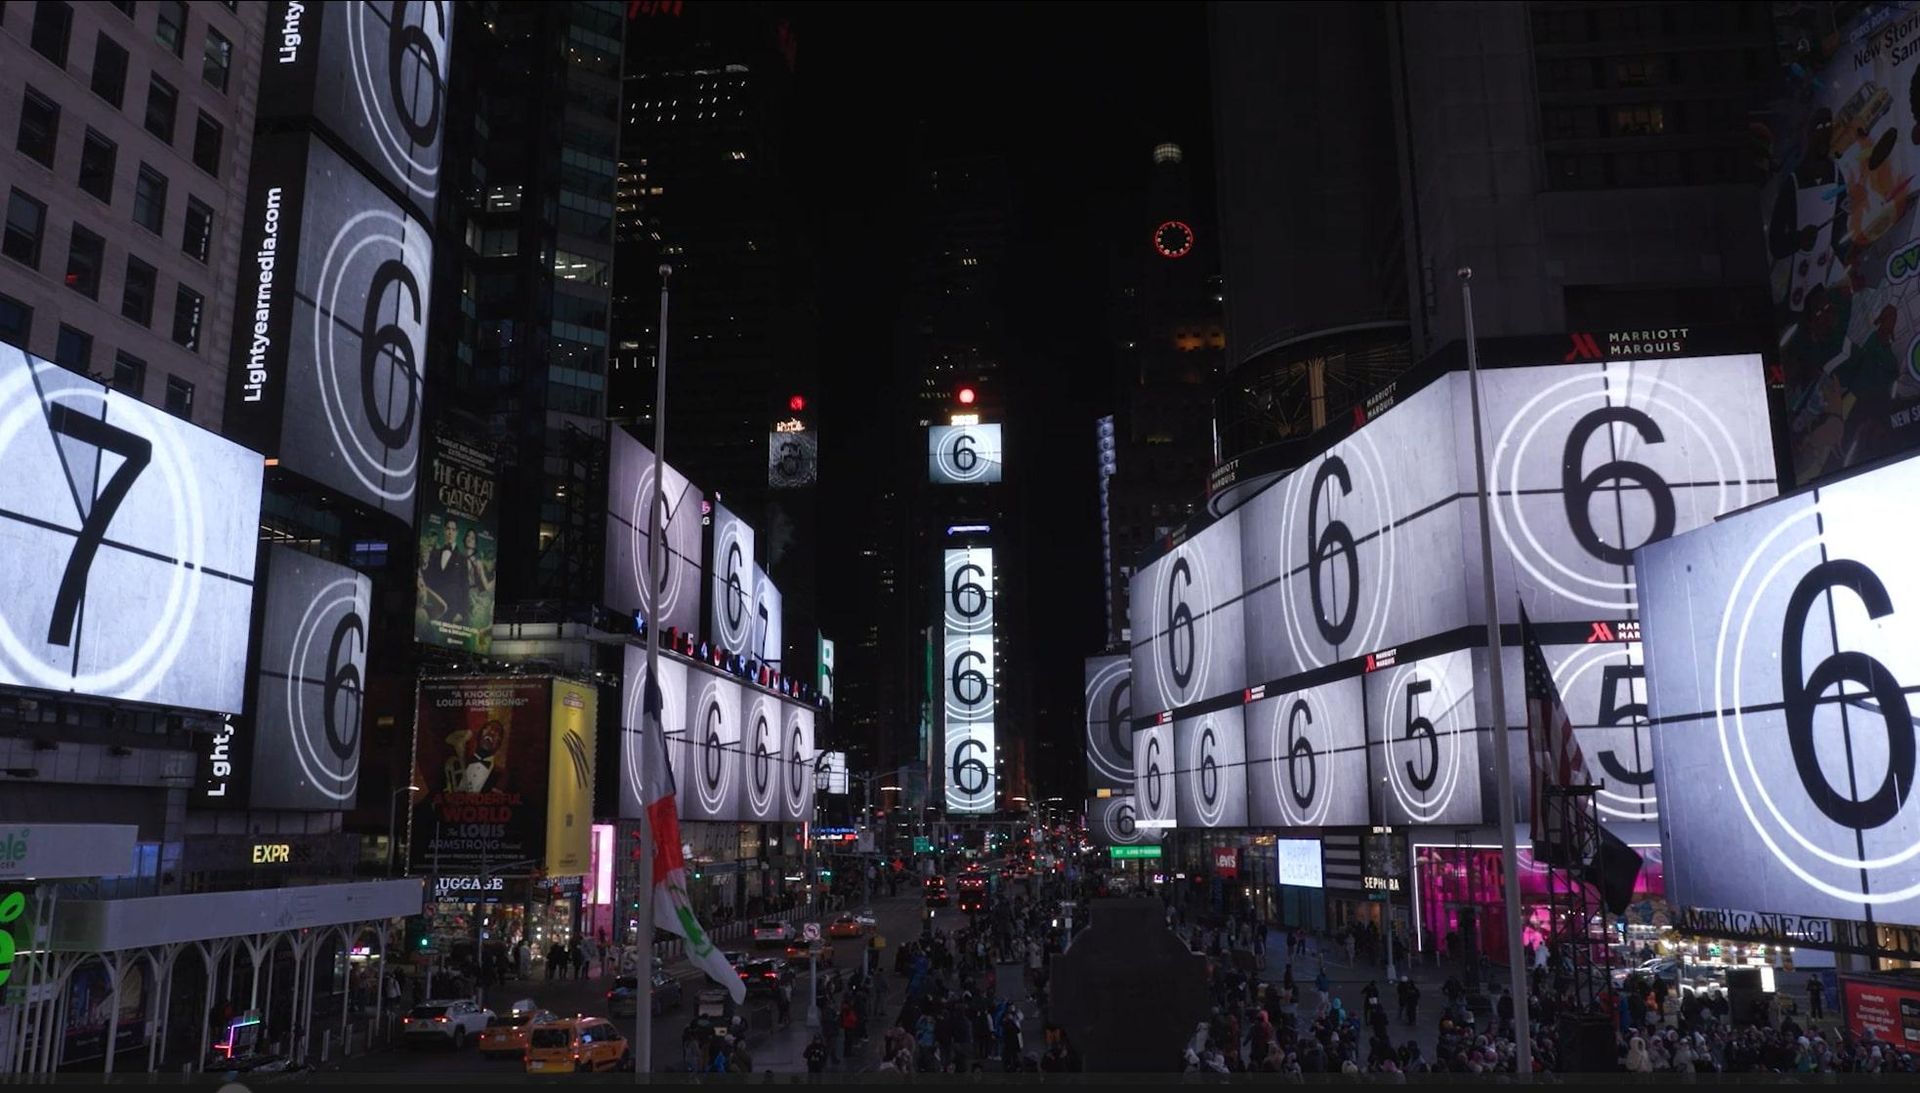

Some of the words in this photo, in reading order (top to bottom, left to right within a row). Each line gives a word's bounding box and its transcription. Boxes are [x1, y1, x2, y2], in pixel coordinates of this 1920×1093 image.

[244, 187, 281, 402] Lightyearmedia.com
[361, 259, 421, 450] 6
[1609, 328, 1689, 342] MARRIOTT
[1610, 341, 1681, 355] MARQUIS
[1366, 381, 1397, 408] MARRIOTT
[1367, 395, 1394, 420] MARQUIS
[953, 435, 977, 471] 6
[1563, 405, 1677, 567] 6
[48, 400, 152, 647] 7
[1308, 455, 1360, 646] 6
[727, 541, 742, 631] 6
[952, 564, 988, 618] 6
[1168, 556, 1195, 689] 6
[324, 613, 364, 760] 6
[436, 699, 463, 708] LOUIS
[464, 689, 514, 699] KNOCKOUT
[952, 651, 988, 705] 6
[1782, 558, 1917, 830] 6
[706, 700, 722, 790] 6
[755, 714, 769, 795] 6
[1287, 698, 1316, 809] 6
[1405, 679, 1438, 792] 5
[1597, 664, 1656, 785] 5
[792, 726, 803, 799] 6
[815, 749, 836, 791] 6
[953, 739, 989, 795] 6
[1147, 737, 1161, 811] 6
[1201, 727, 1217, 806] 6
[428, 839, 501, 851] ARMSTRONG
[443, 806, 513, 823] WORLD
[460, 824, 507, 839] LOUIS
[1116, 805, 1135, 836] 6
[253, 844, 290, 863] EXPR
[1680, 907, 1776, 941] AMERICAN
